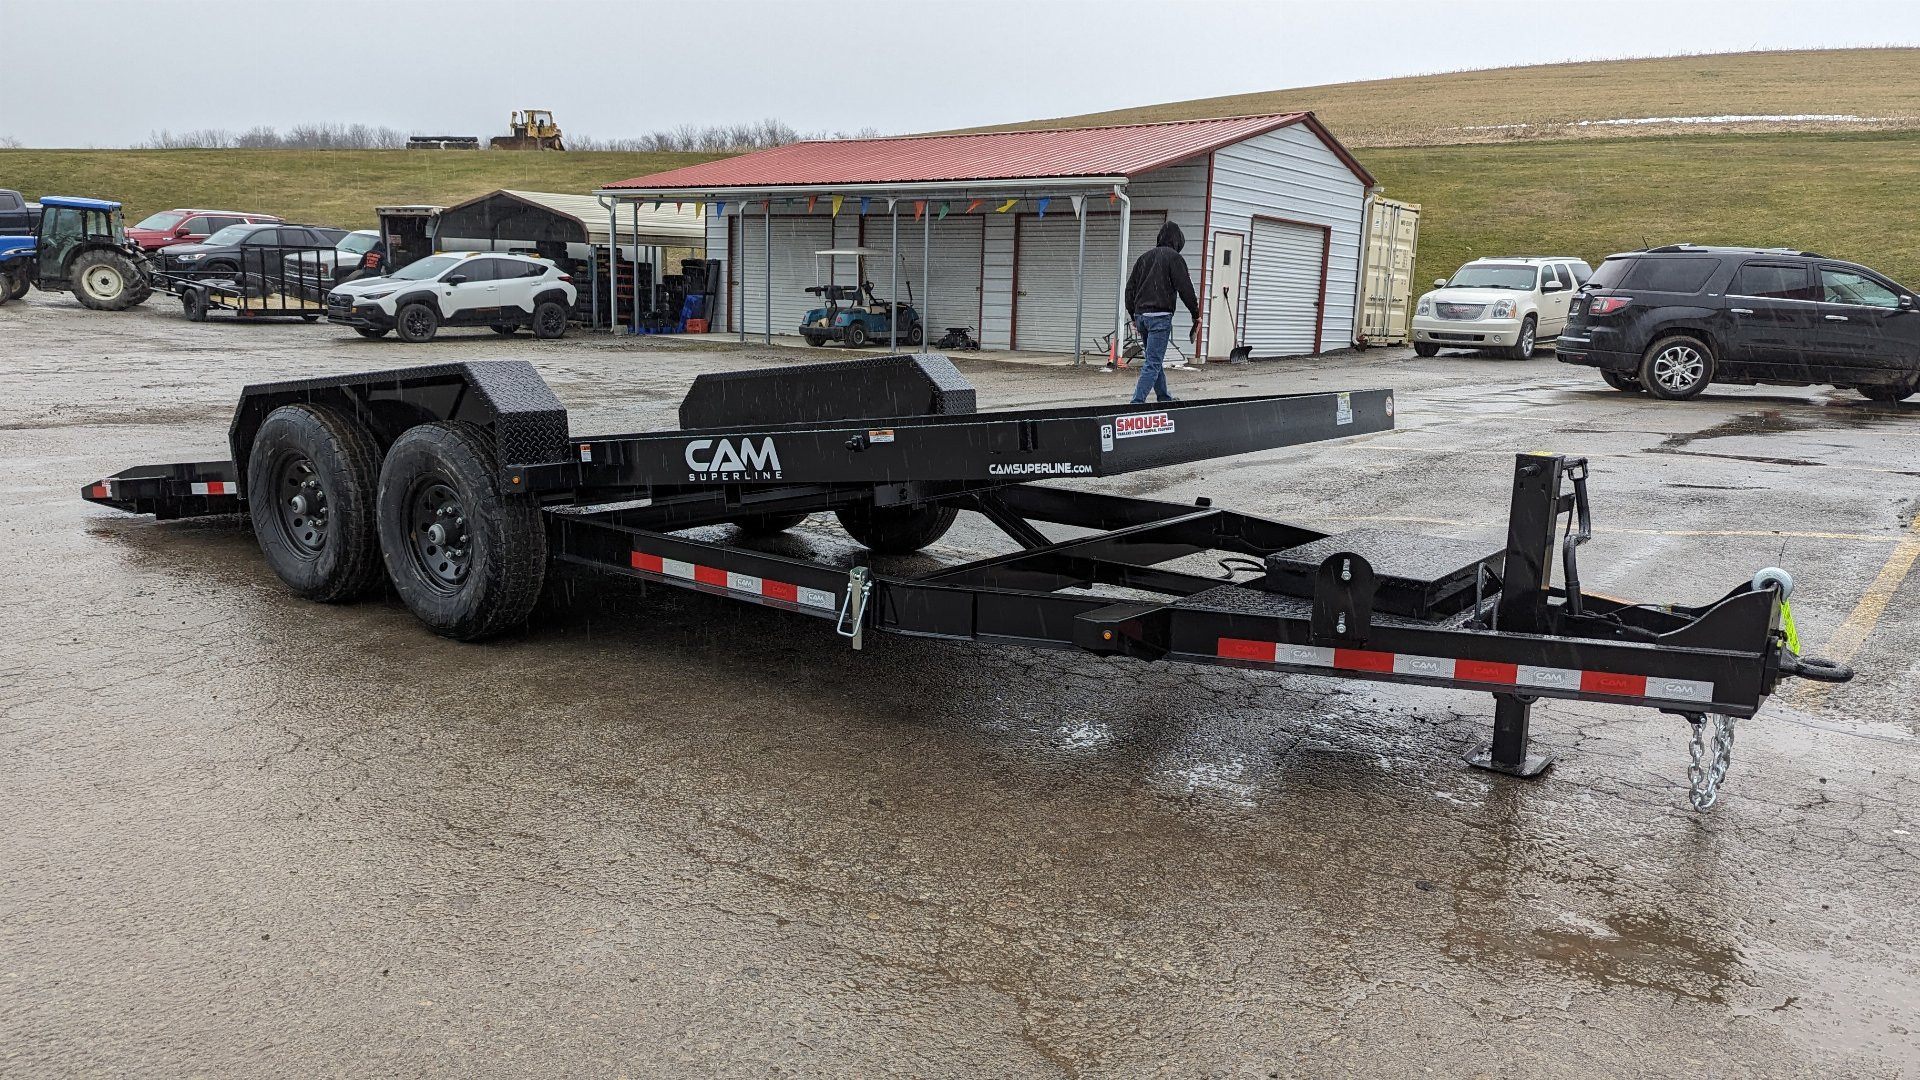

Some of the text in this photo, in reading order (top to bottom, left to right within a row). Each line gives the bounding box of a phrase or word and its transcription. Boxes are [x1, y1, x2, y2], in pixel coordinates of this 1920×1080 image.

[1116, 415, 1167, 432] SMOUSE
[685, 436, 781, 472] CAM
[689, 471, 782, 481] SUPERLINE
[737, 578, 752, 587] CAM
[808, 593, 825, 602] CAM
[1293, 649, 1317, 659] CAM
[1412, 661, 1437, 670] CAM
[1536, 672, 1562, 681] CAM
[1666, 684, 1693, 693] CAM
